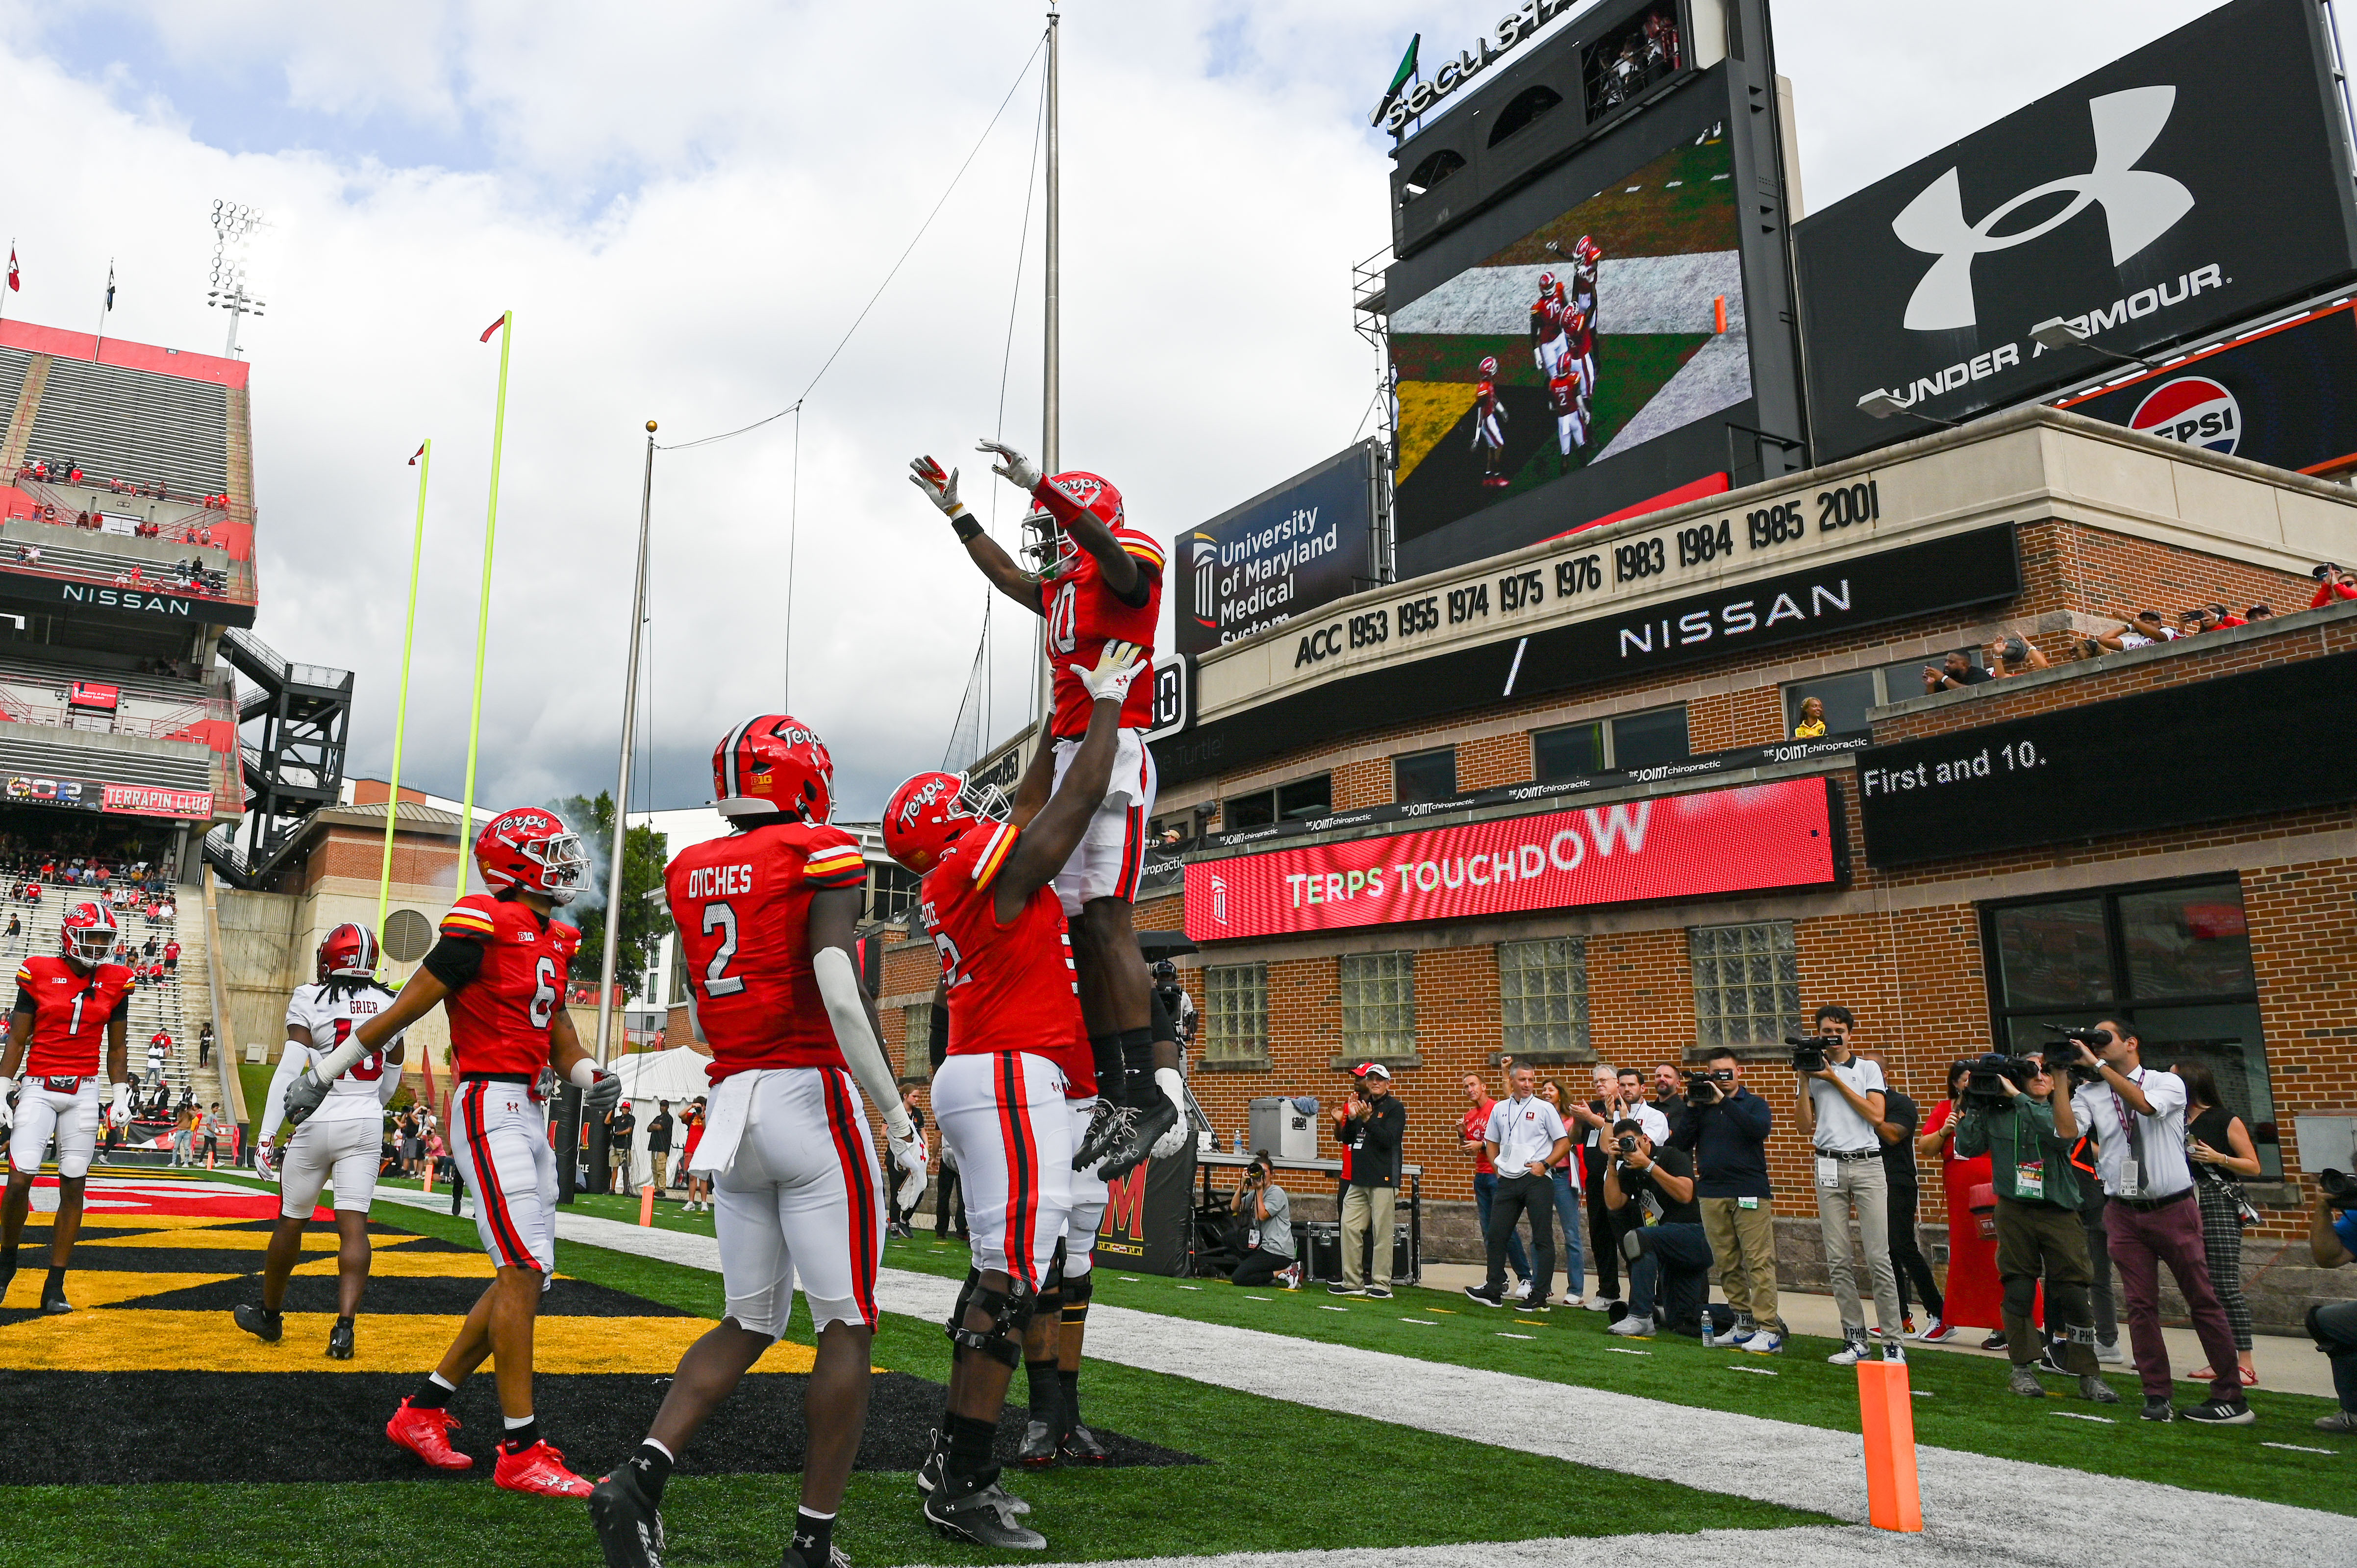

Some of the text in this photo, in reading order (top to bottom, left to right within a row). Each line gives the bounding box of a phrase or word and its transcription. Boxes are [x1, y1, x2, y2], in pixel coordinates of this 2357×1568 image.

[1546, 298, 1561, 319] 76
[1892, 263, 2223, 408] UNDER RMOUR
[2154, 407, 2234, 444] EPSI
[1057, 478, 1102, 497] erps
[1221, 507, 1319, 568] University
[1220, 523, 1338, 597] of Maryland
[1295, 480, 1880, 668] ACC 1953 1955 1974 1975 1976 1983 1984 1985 2001
[63, 585, 189, 615] NISSAN
[1220, 573, 1295, 627] Medical
[1048, 581, 1077, 659] 10
[1619, 578, 1851, 658] NISSAN
[1152, 670, 1176, 723] 0
[1762, 738, 1867, 762] THE JOINT chiropractic
[1629, 760, 1721, 782] THE JOINT chiropractic
[1863, 740, 2047, 797] First and 10.
[6, 776, 82, 802] 602
[107, 789, 210, 811] TERRAPIN CLUB
[900, 777, 946, 828] Terps
[1515, 785, 1544, 800] JOINT
[1542, 779, 1591, 793] chiropractic
[1408, 802, 1433, 817] JOINT
[1432, 798, 1475, 810] chiropractic
[493, 815, 548, 838] Terps
[1310, 817, 1334, 831] JOINT
[1333, 814, 1372, 825] chiropractic
[1224, 833, 1245, 846] JOINT
[1244, 828, 1279, 840] chiropractic
[1142, 856, 1185, 876] hiropractic
[689, 864, 752, 898] DYCHES
[1286, 868, 1385, 908] TERPS
[922, 901, 941, 928] OZE
[517, 931, 535, 942] B1G
[702, 901, 746, 999] 2
[934, 931, 974, 987] 2
[528, 956, 556, 1029] 6
[70, 993, 84, 1035] 1
[350, 1000, 378, 1015] GRIER
[1742, 1314, 1754, 1324] PHO
[1850, 1328, 1867, 1339] PHO
[2080, 1330, 2094, 1342] PHO
